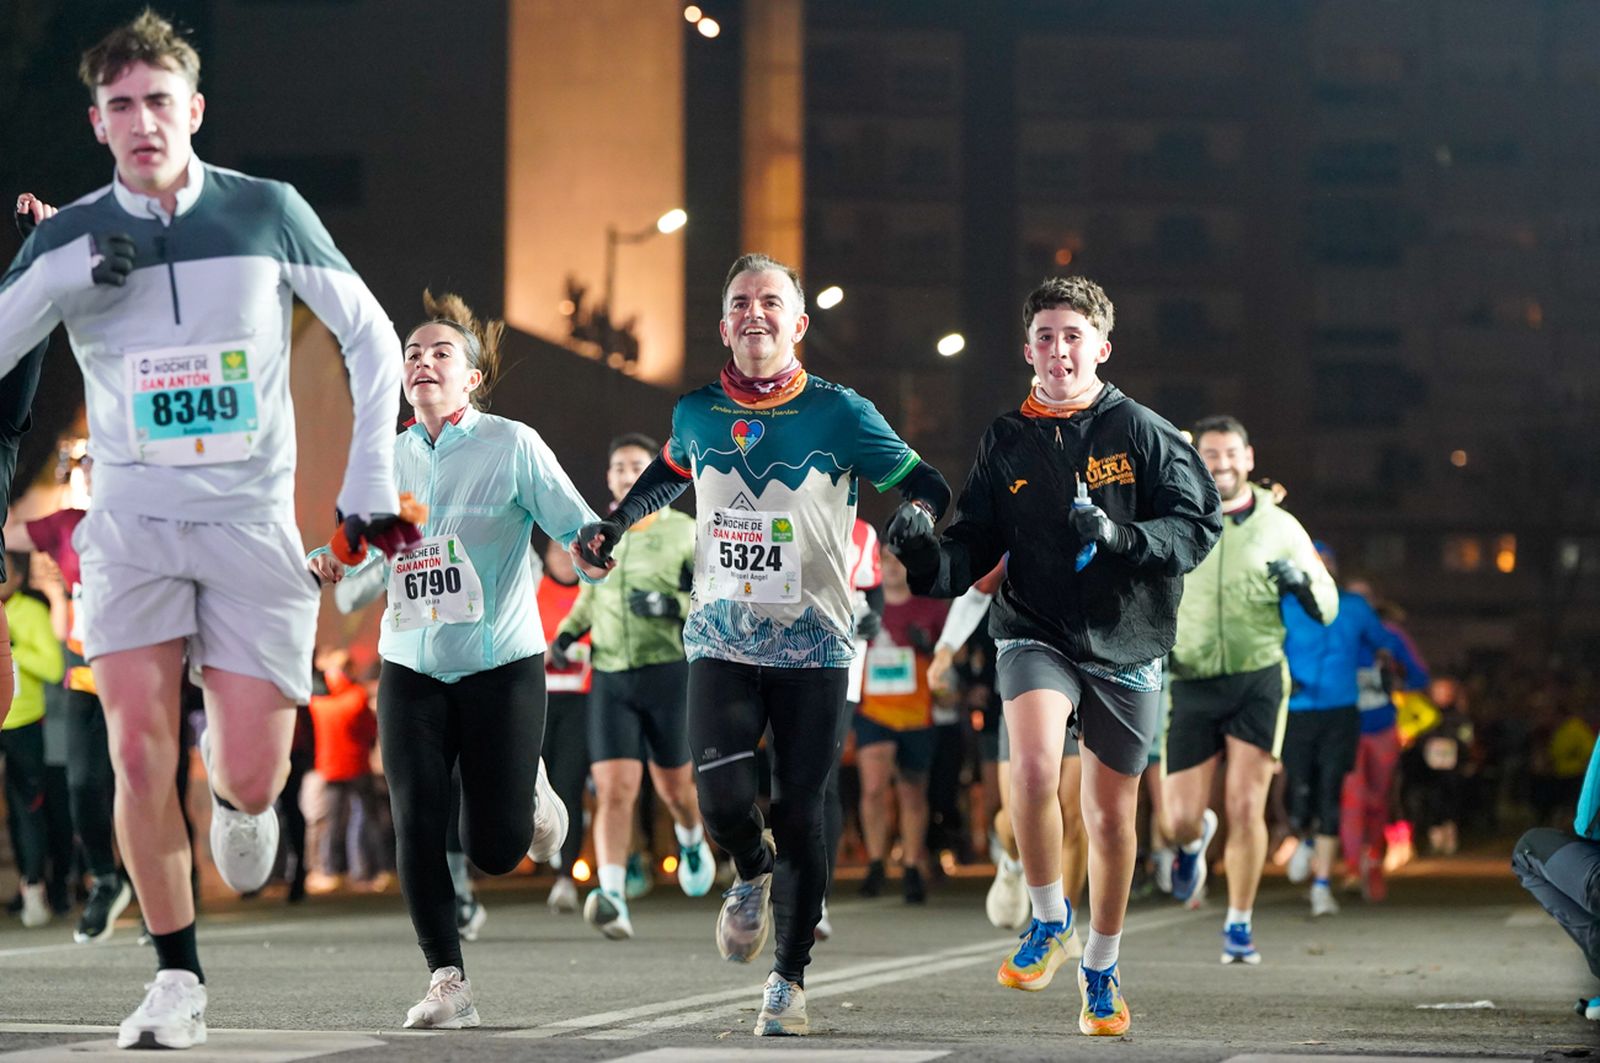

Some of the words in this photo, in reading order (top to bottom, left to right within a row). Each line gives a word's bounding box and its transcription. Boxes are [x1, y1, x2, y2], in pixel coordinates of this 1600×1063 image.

[155, 360, 191, 373] NOCHE
[195, 358, 208, 370] DE
[141, 378, 165, 390] SAN
[168, 371, 210, 388] ANTÓN
[152, 386, 238, 426] 8349
[1086, 458, 1132, 483] ULTRA
[723, 519, 749, 530] NOCHE
[751, 522, 763, 531] DE
[713, 528, 729, 539] SAN
[730, 530, 763, 543] ANTÓN
[429, 546, 440, 556] DE
[719, 541, 782, 572] 5324
[396, 561, 413, 574] SAN
[412, 555, 441, 571] ANTÓN
[404, 566, 462, 600] 6790
